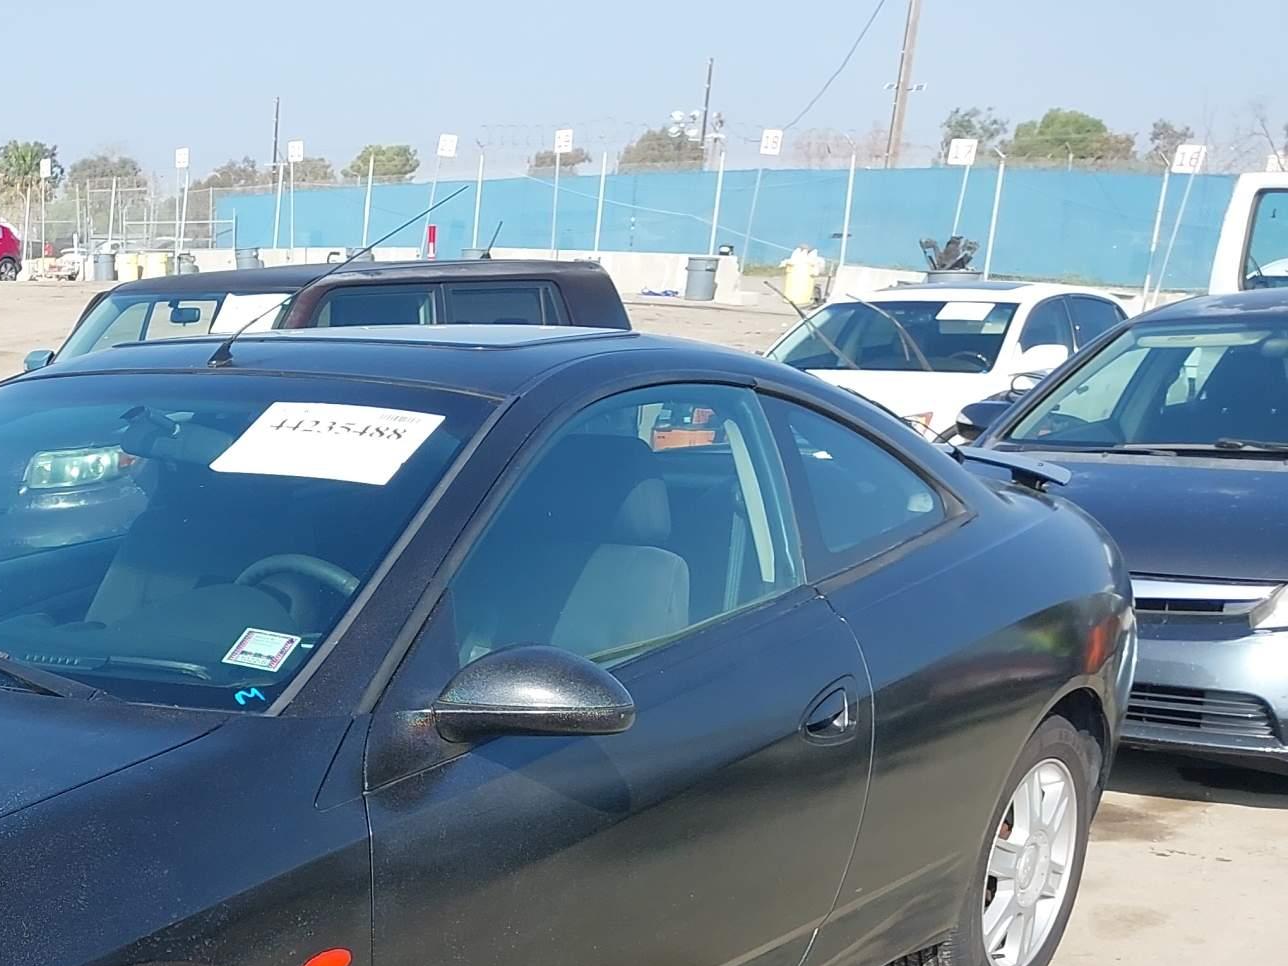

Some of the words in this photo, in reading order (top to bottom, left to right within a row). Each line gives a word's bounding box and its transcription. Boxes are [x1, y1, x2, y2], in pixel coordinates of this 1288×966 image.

[952, 143, 974, 160] 17
[1175, 151, 1201, 168] 16
[270, 417, 407, 440] 44235488
